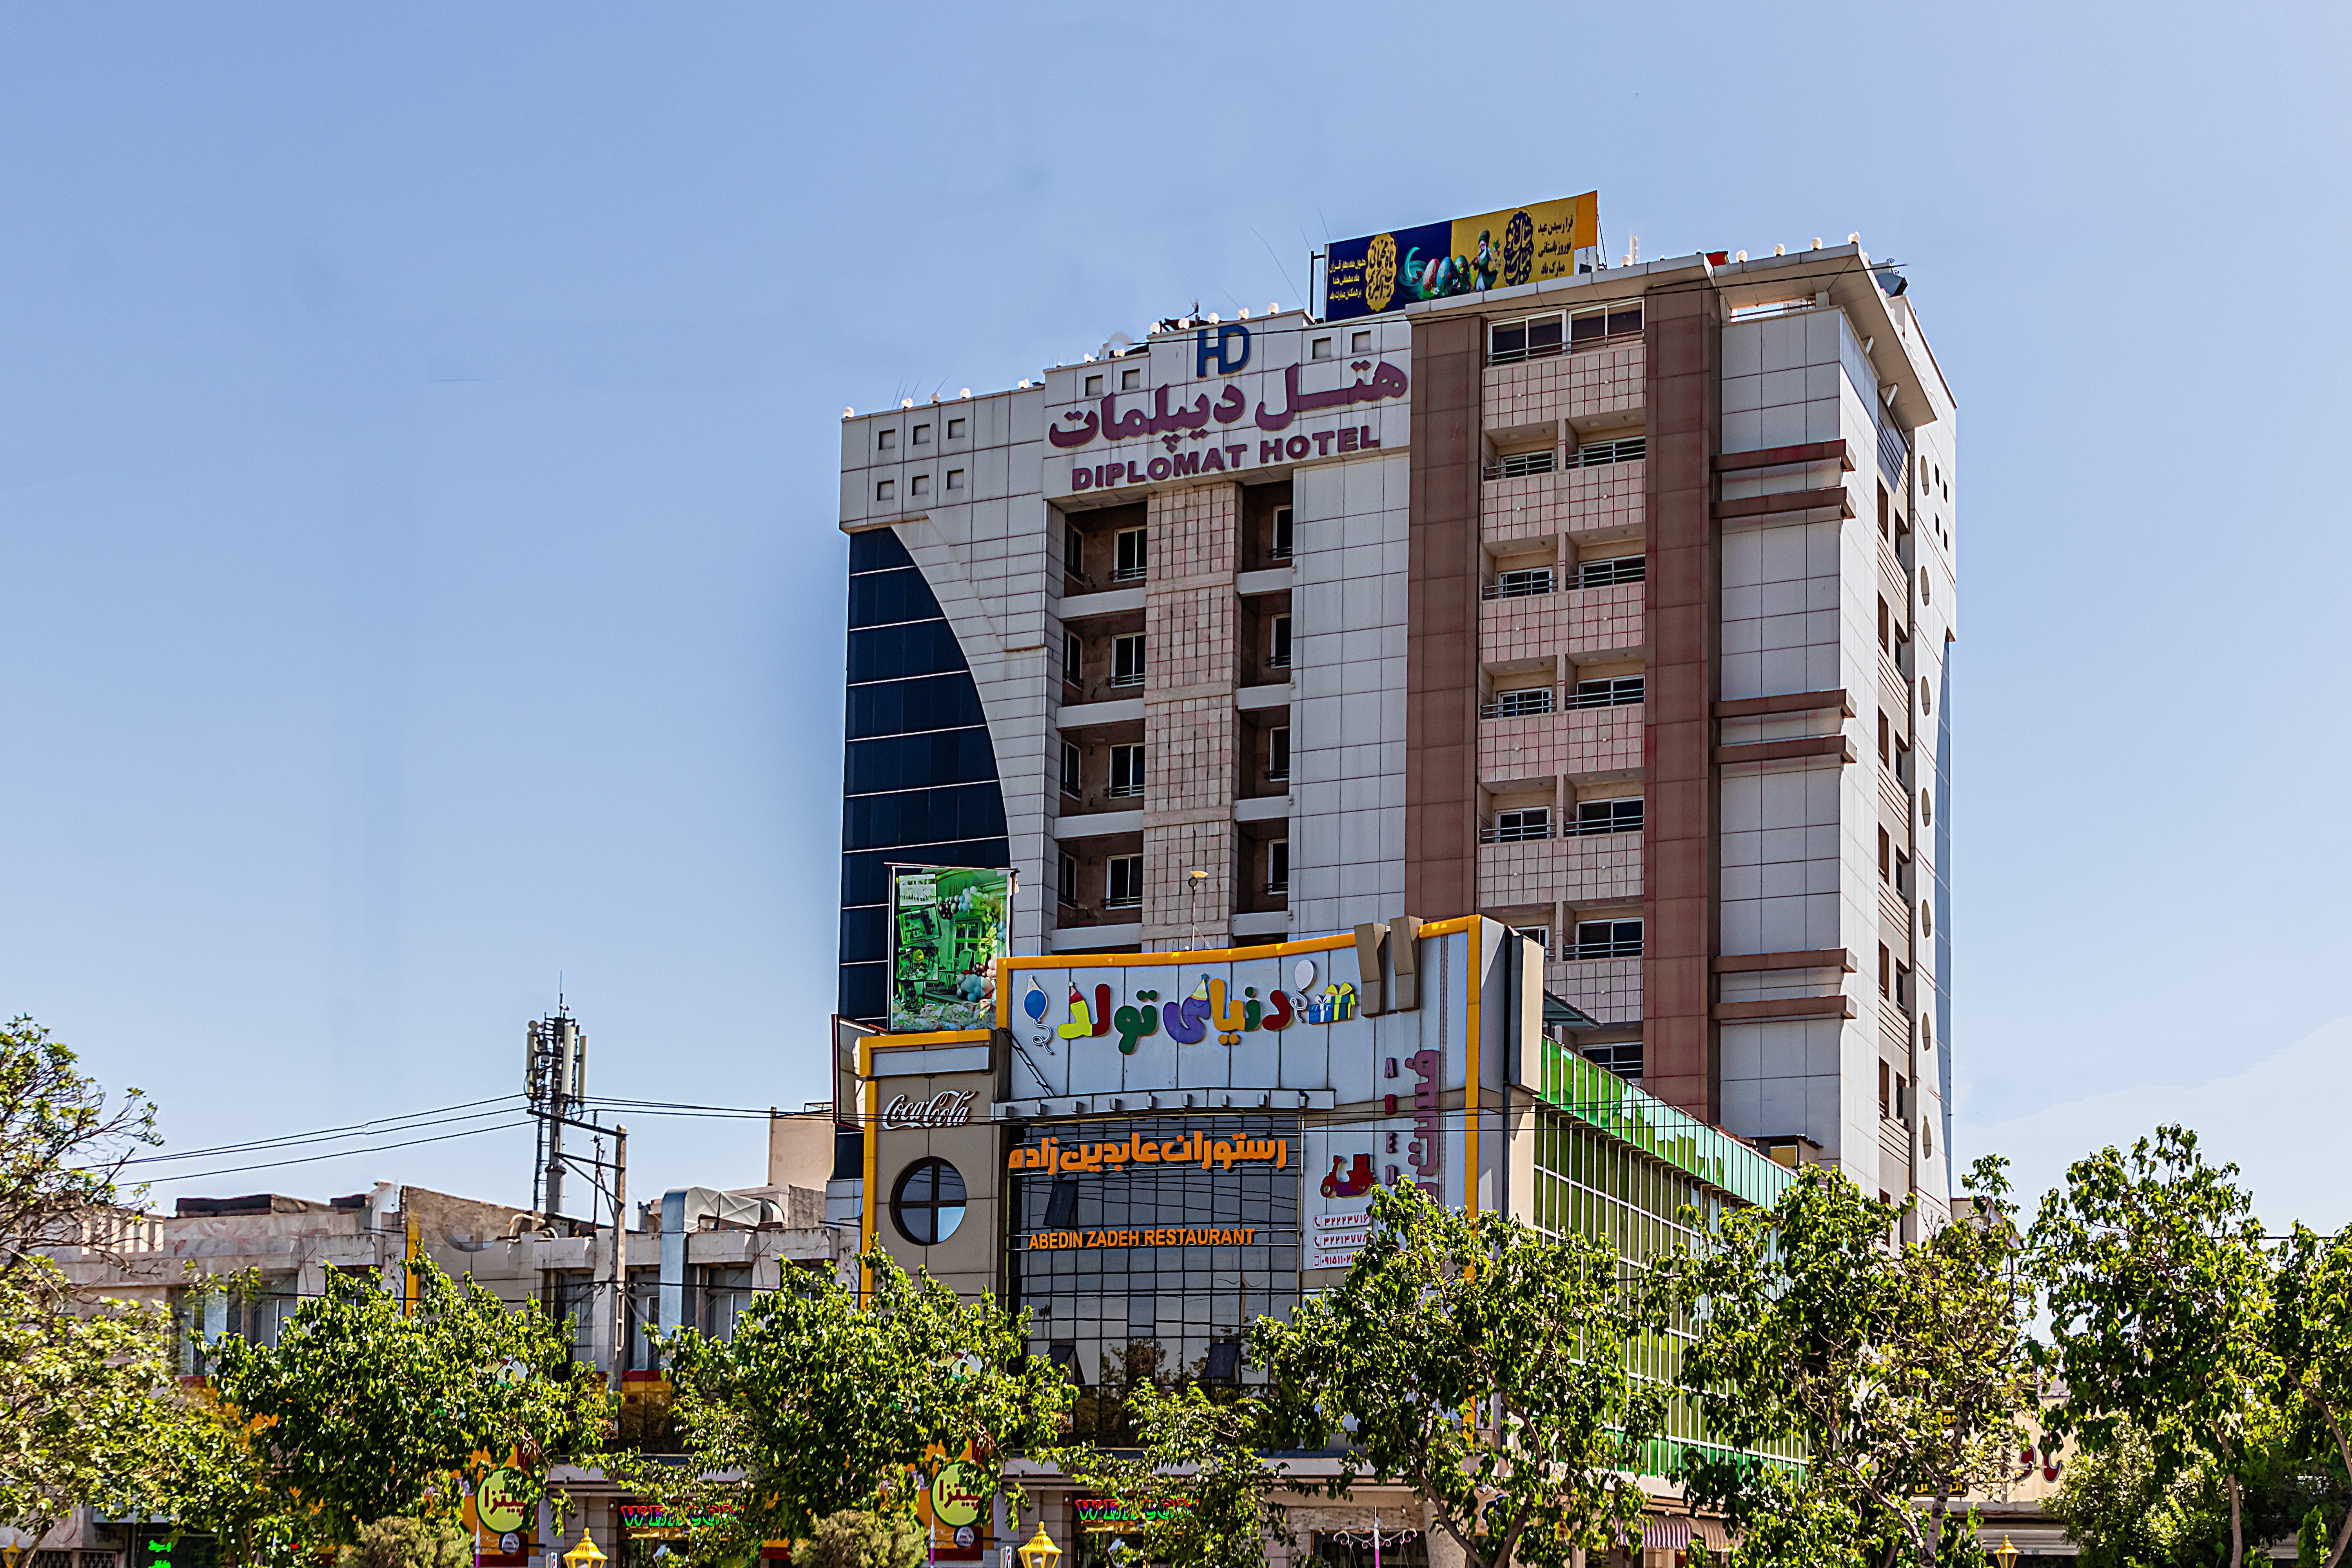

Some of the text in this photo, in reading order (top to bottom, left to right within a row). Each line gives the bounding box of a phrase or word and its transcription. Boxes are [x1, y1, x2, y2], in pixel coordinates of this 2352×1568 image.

[1549, 260, 1565, 277] مبارک
[1196, 324, 1250, 377] HD
[1049, 359, 1408, 453] هتل دیپلمات
[1071, 425, 1380, 491] DIPLOMAT HOTEL
[1057, 976, 1294, 1055] دنیای تولد
[1009, 1131, 1287, 1176] رستوران عابدین زاده
[1029, 1228, 1255, 1250] ABEDIN ZADEH RESTAURANT
